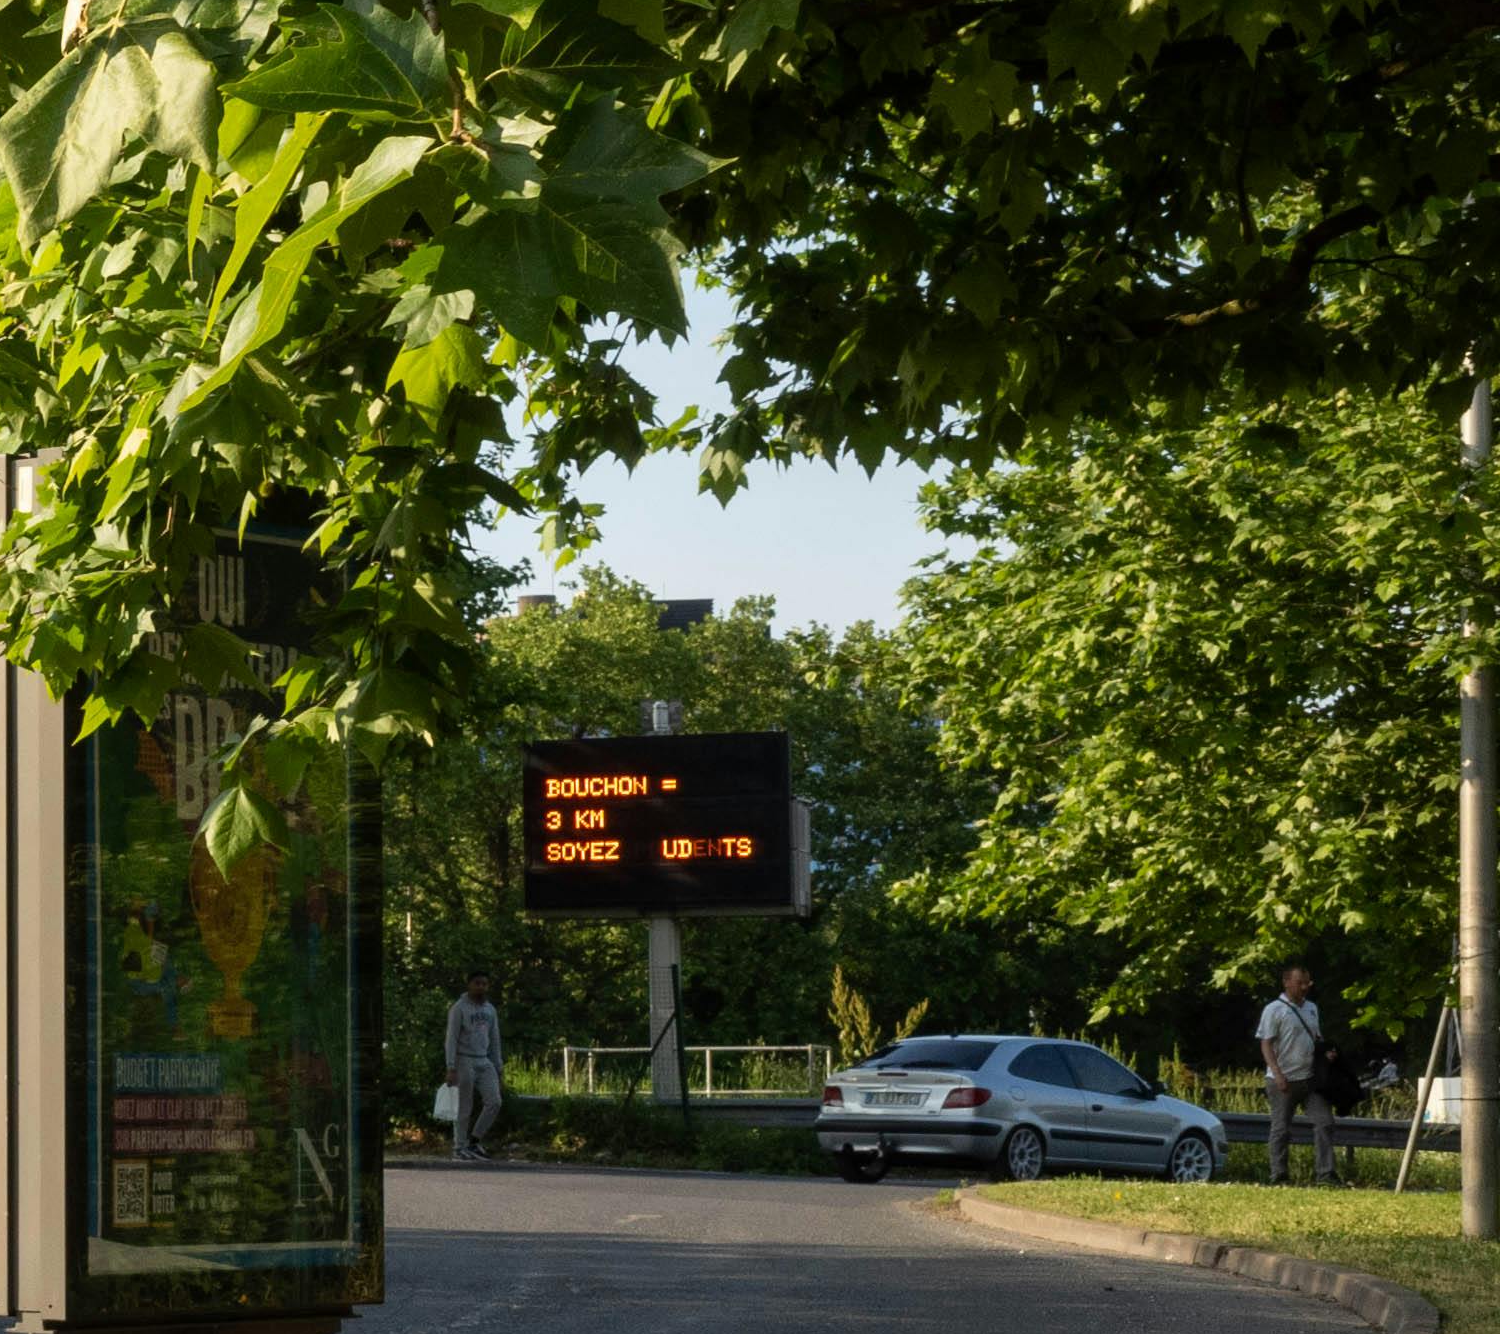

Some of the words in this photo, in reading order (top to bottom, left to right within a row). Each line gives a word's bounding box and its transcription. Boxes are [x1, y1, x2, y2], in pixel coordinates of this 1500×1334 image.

[545, 776, 648, 798] BOUCHON
[546, 810, 562, 830] 3
[575, 809, 605, 829] KM
[546, 840, 620, 862] SOYEZ
